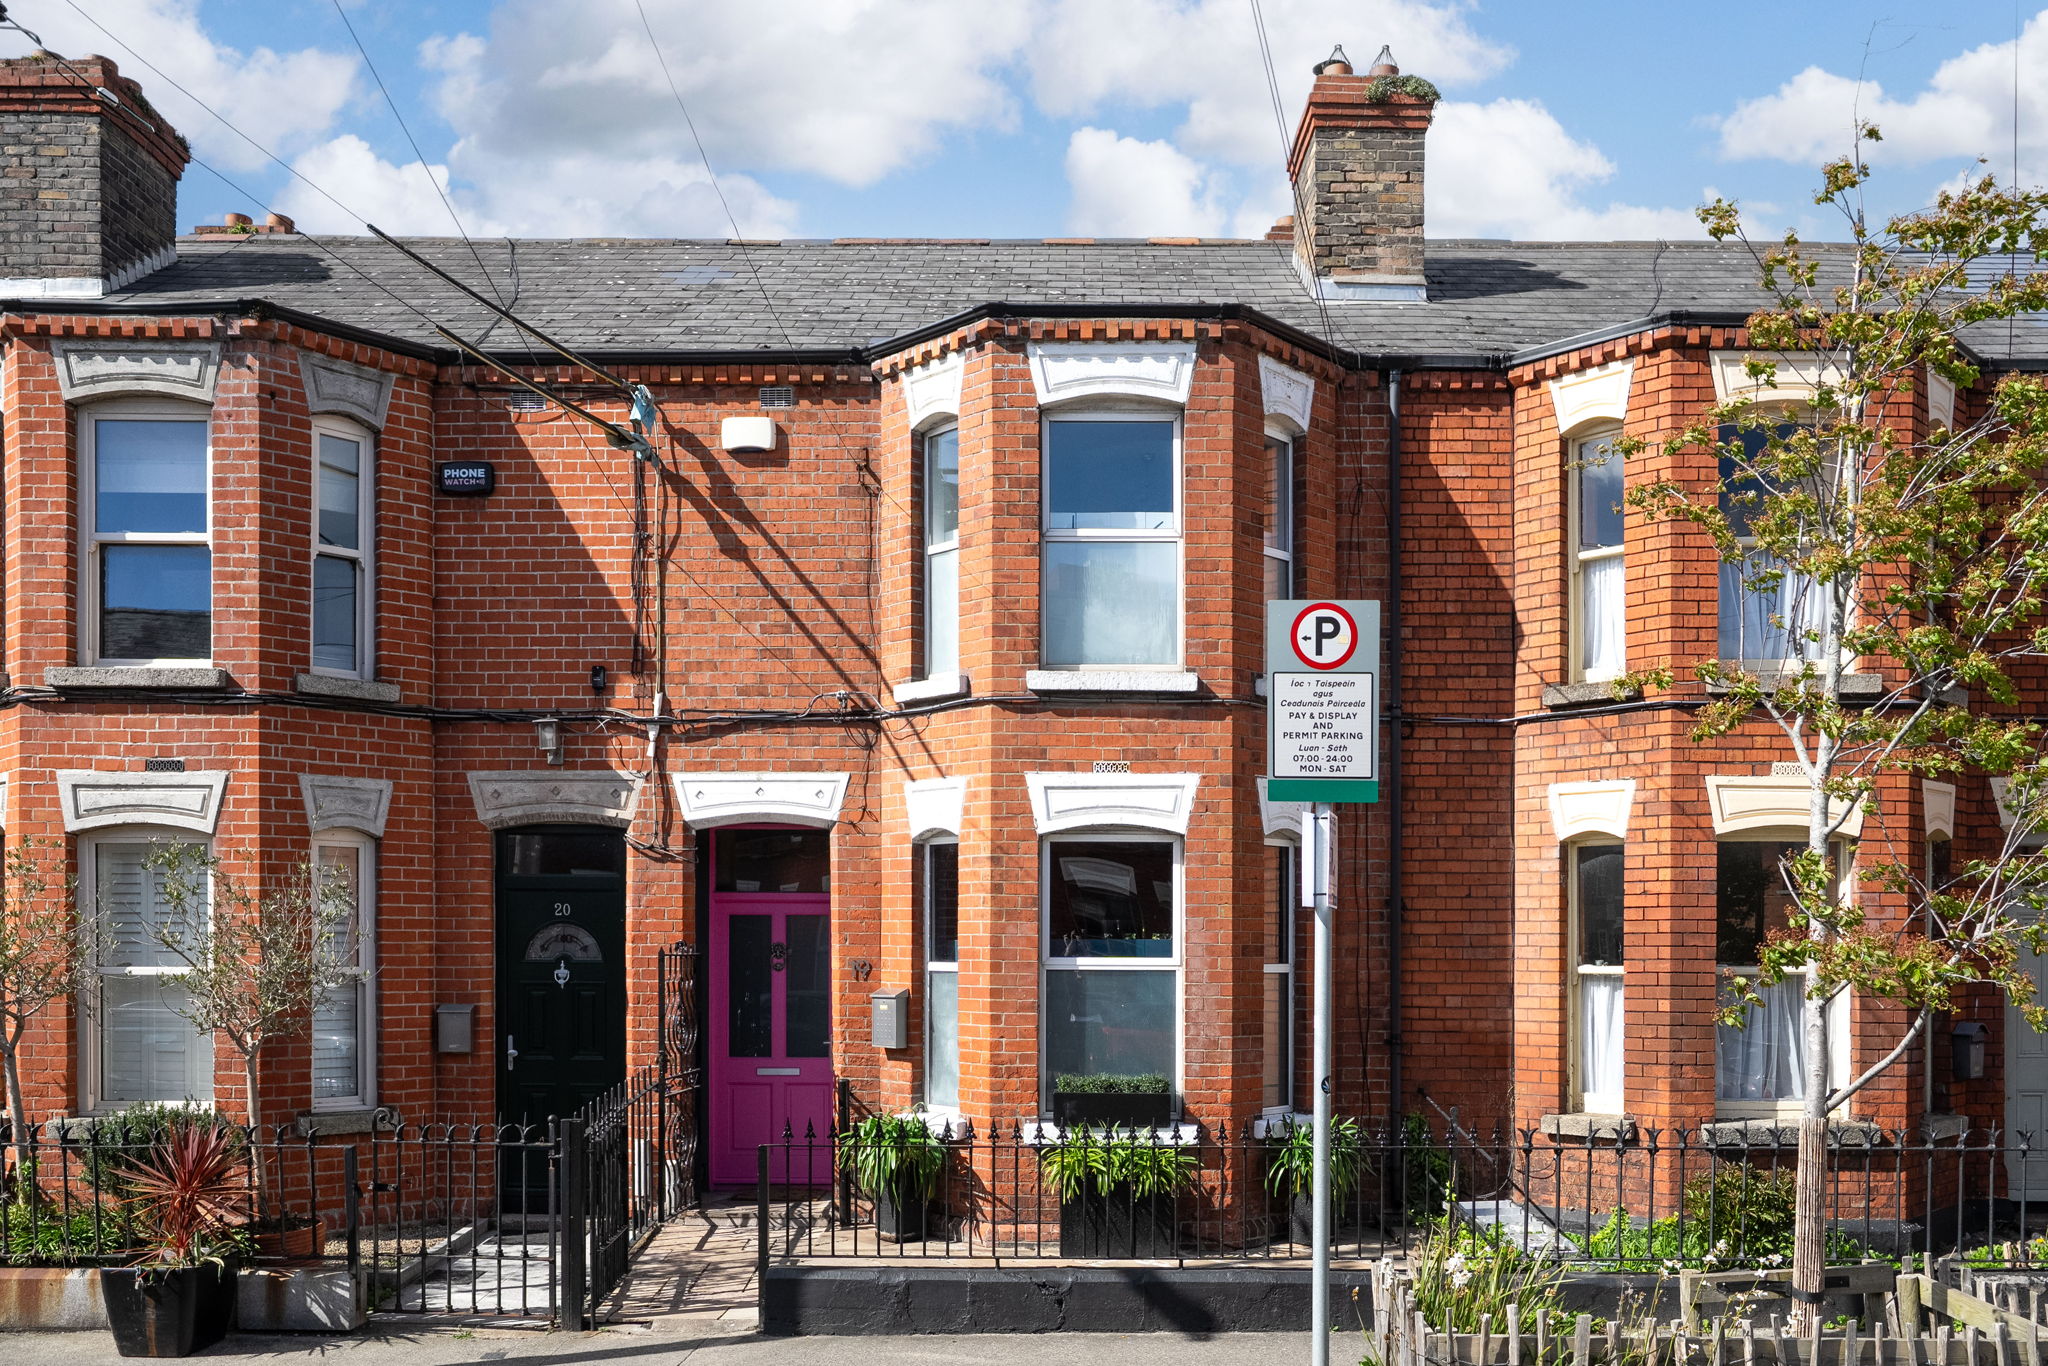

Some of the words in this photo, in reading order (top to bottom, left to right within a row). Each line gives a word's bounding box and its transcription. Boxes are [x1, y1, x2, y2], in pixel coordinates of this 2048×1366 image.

[444, 468, 486, 478] PHONE
[1315, 616, 1341, 656] P
[1288, 712, 1307, 720] PAY
[1309, 712, 1316, 720] &
[1318, 712, 1358, 720] DISPLAY
[1312, 722, 1334, 730] AND
[1282, 732, 1319, 740] PERMIT
[1321, 732, 1364, 740] PARKING
[1298, 744, 1320, 752] Luan
[1292, 755, 1320, 763] 07:00
[1325, 755, 1353, 763] 24:00
[1328, 765, 1347, 773] SAT
[554, 902, 571, 916] 20
